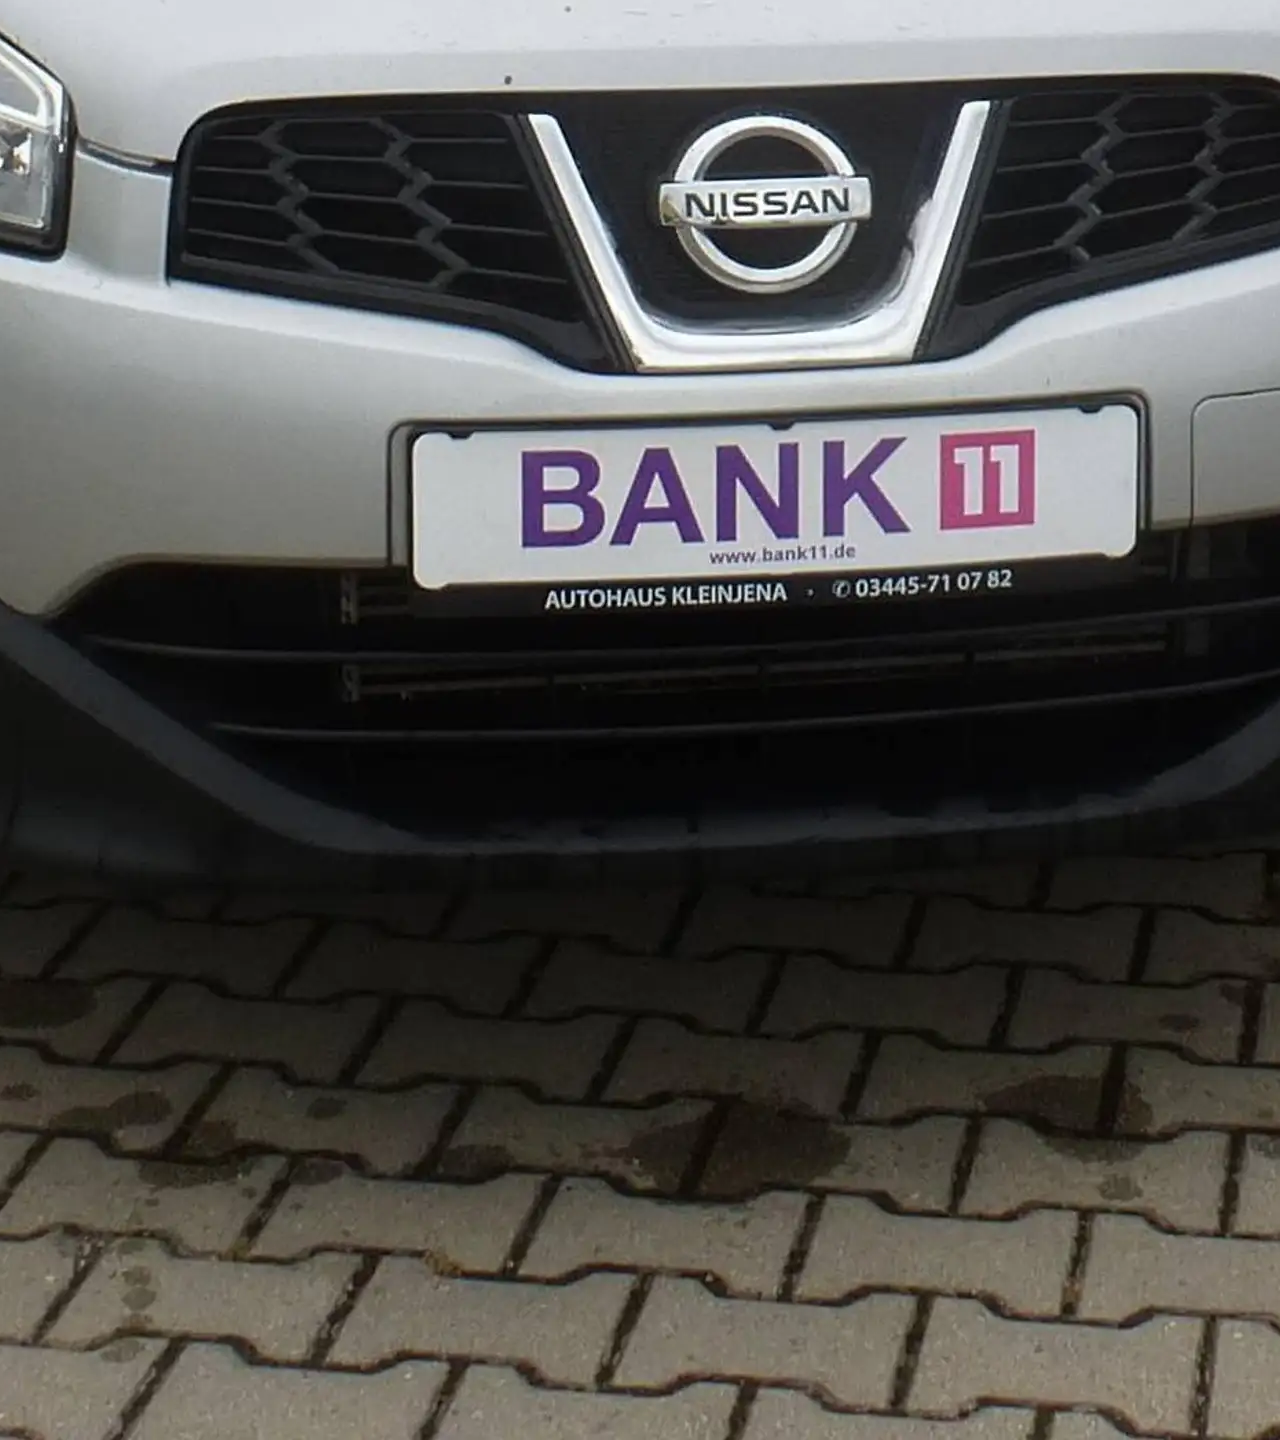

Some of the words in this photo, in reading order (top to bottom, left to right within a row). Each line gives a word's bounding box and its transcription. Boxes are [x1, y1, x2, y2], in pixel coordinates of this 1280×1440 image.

[684, 187, 850, 218] NISSAN
[521, 436, 911, 549] BANK
[948, 437, 1026, 522] 11
[709, 544, 856, 564] www.bank11.de
[545, 586, 667, 610] AUTOHAUS
[672, 582, 787, 606] KLEINJENA
[855, 573, 951, 598] 03445-71
[957, 573, 982, 594] 07
[987, 569, 1012, 591] 82
